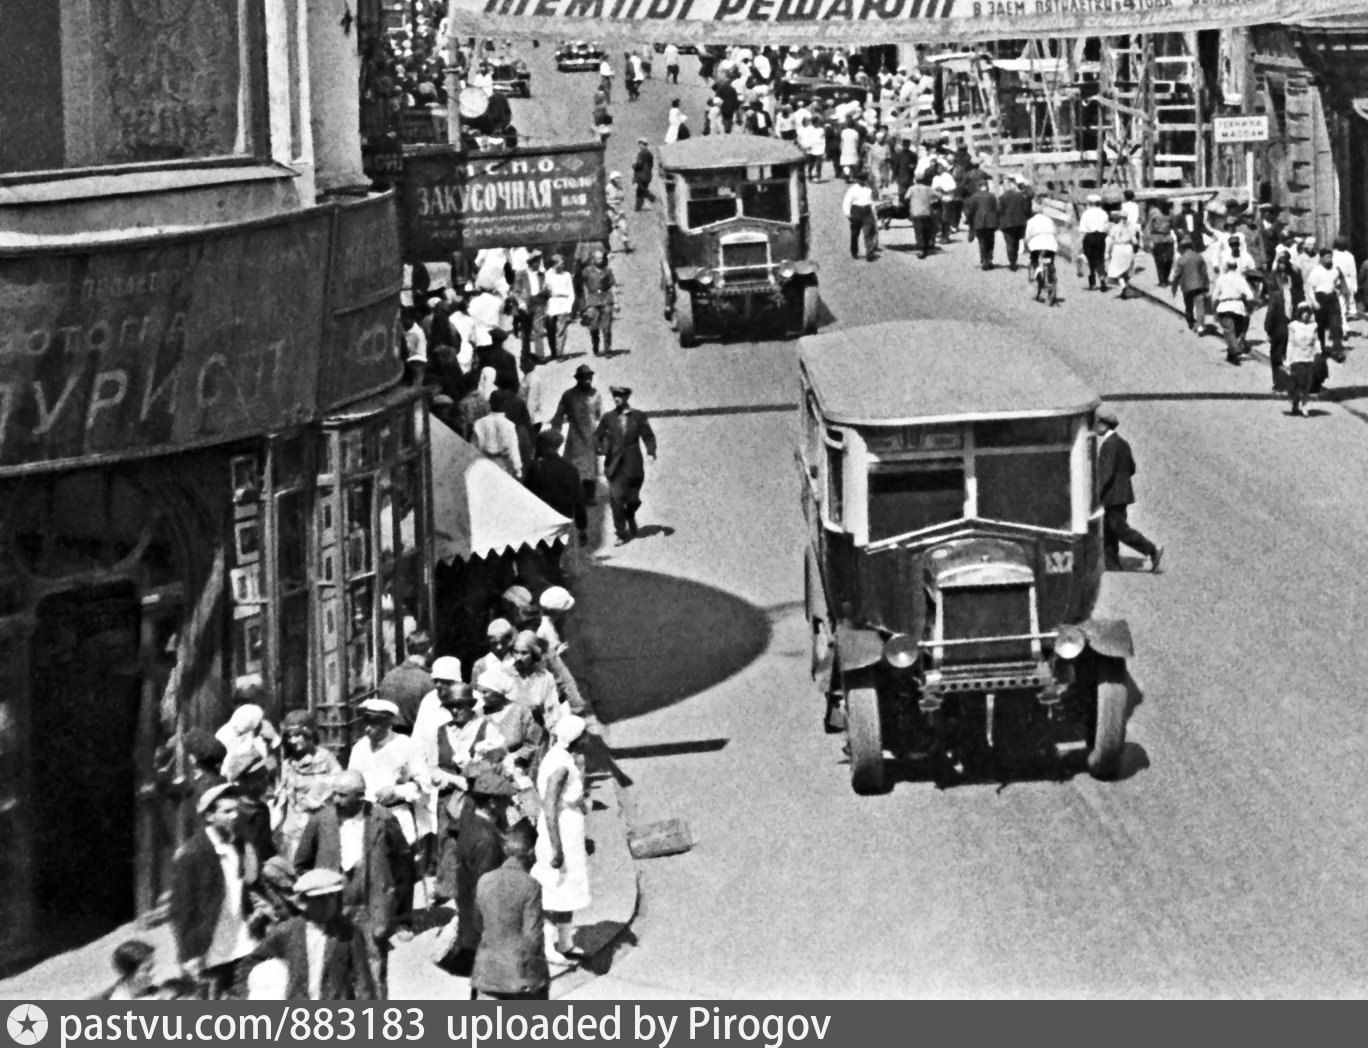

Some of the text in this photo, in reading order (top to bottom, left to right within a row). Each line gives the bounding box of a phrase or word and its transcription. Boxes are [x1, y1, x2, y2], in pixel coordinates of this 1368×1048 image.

[973, 2, 982, 17] В
[988, 0, 1026, 16] ЗАЕМ
[417, 178, 553, 216] ЗАКУСОЧНАЯ
